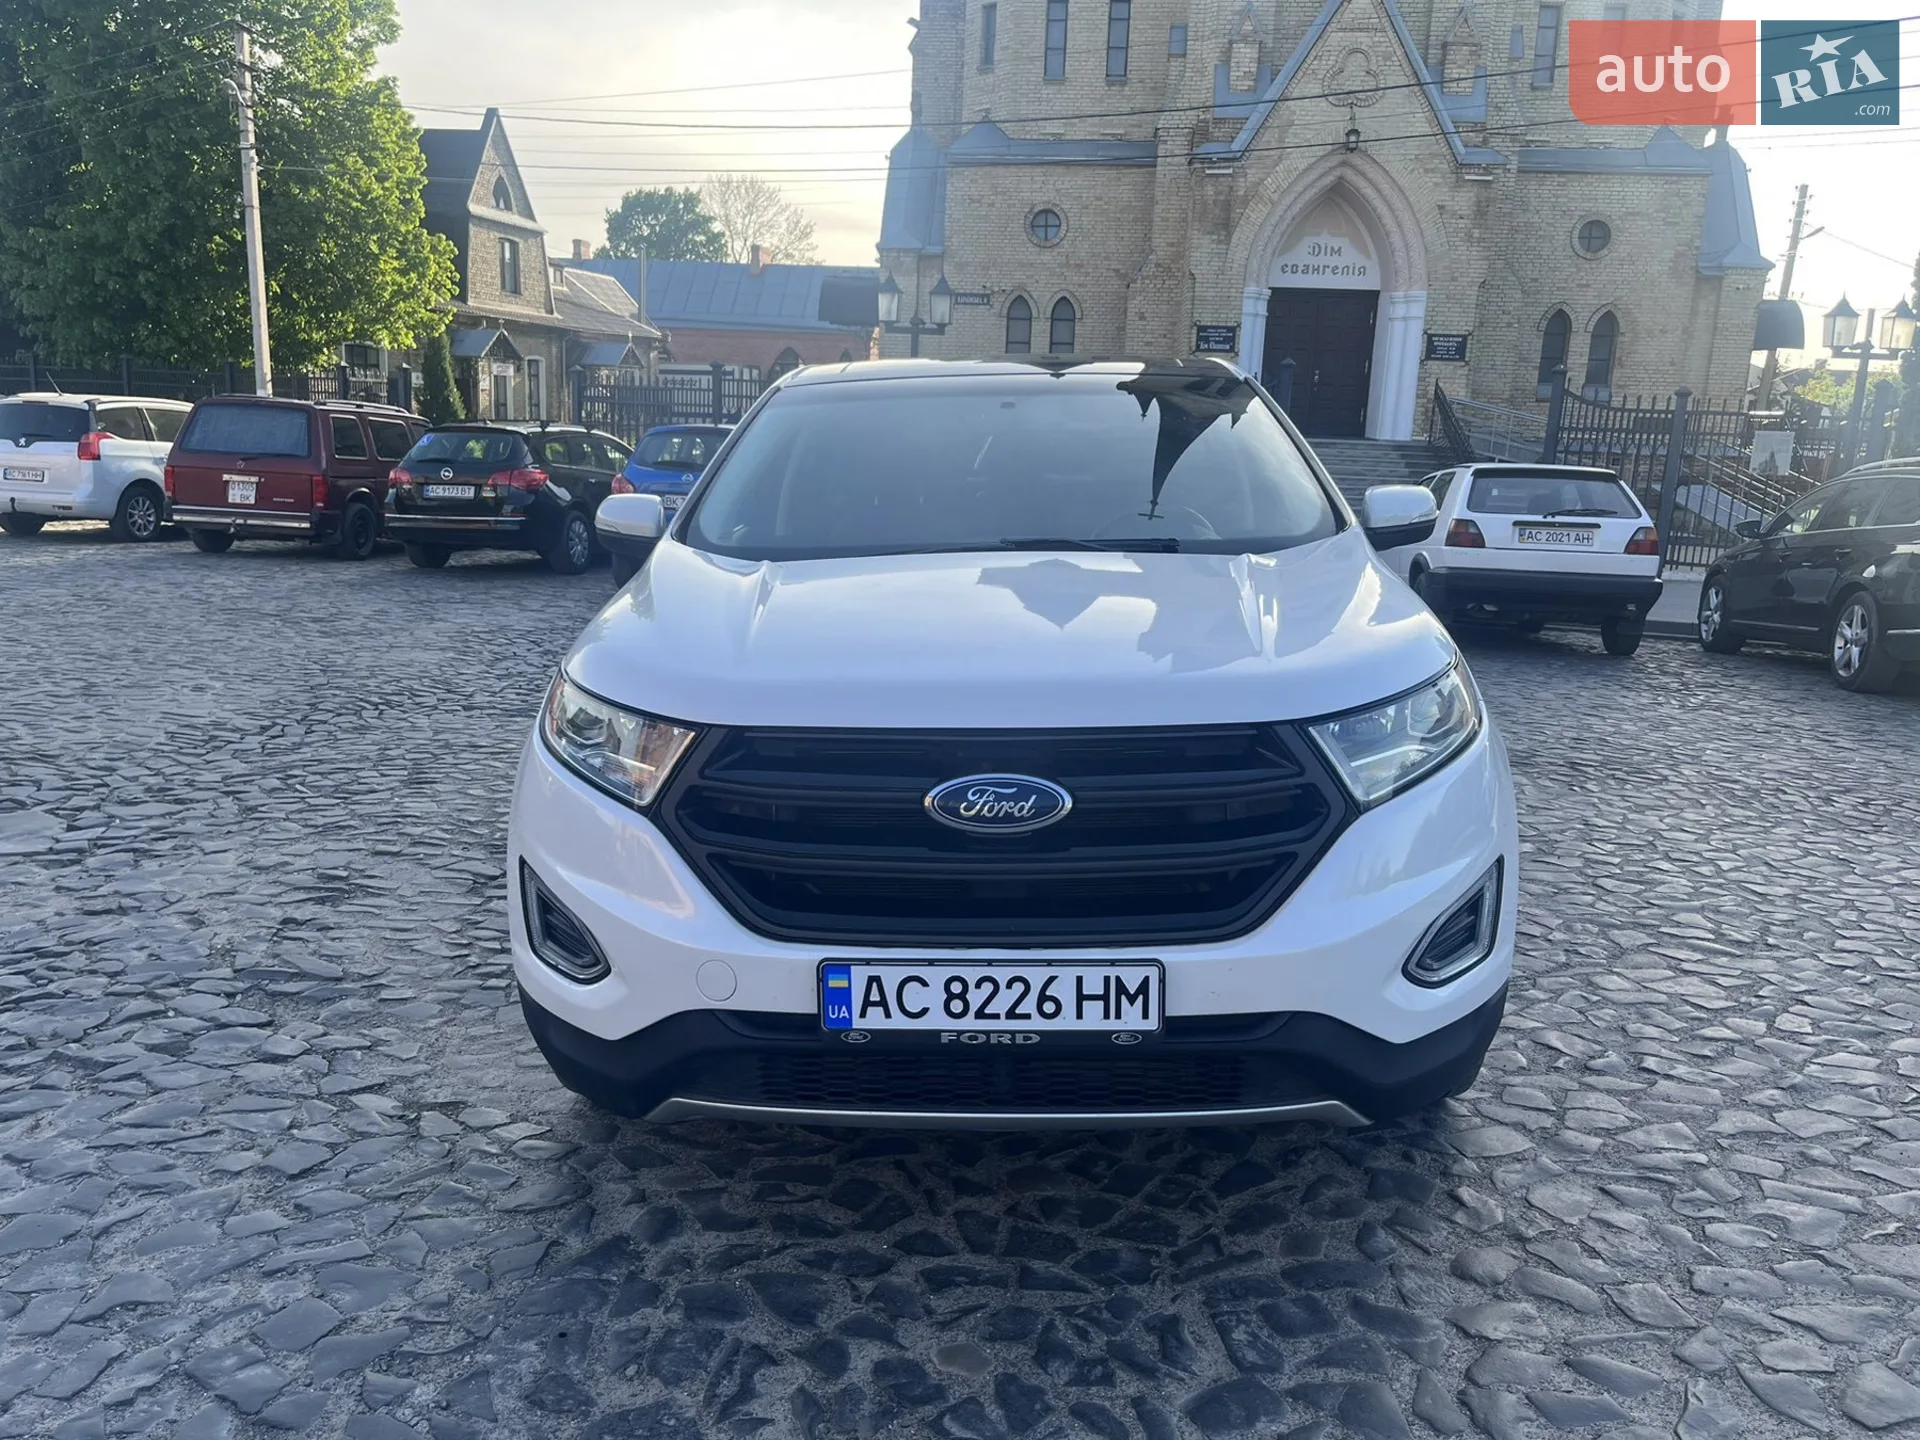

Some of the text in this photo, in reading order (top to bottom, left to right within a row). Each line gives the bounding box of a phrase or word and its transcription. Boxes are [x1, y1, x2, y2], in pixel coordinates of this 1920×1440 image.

[1308, 242, 1342, 257] Дім
[430, 486, 472, 495] AC 9173 BT
[1526, 530, 1590, 544] AC 2021 AH
[959, 785, 1038, 818] Ford
[859, 974, 1151, 1020] AC 8226 HM
[828, 1004, 850, 1020] UA
[940, 1032, 1041, 1044] FORD
